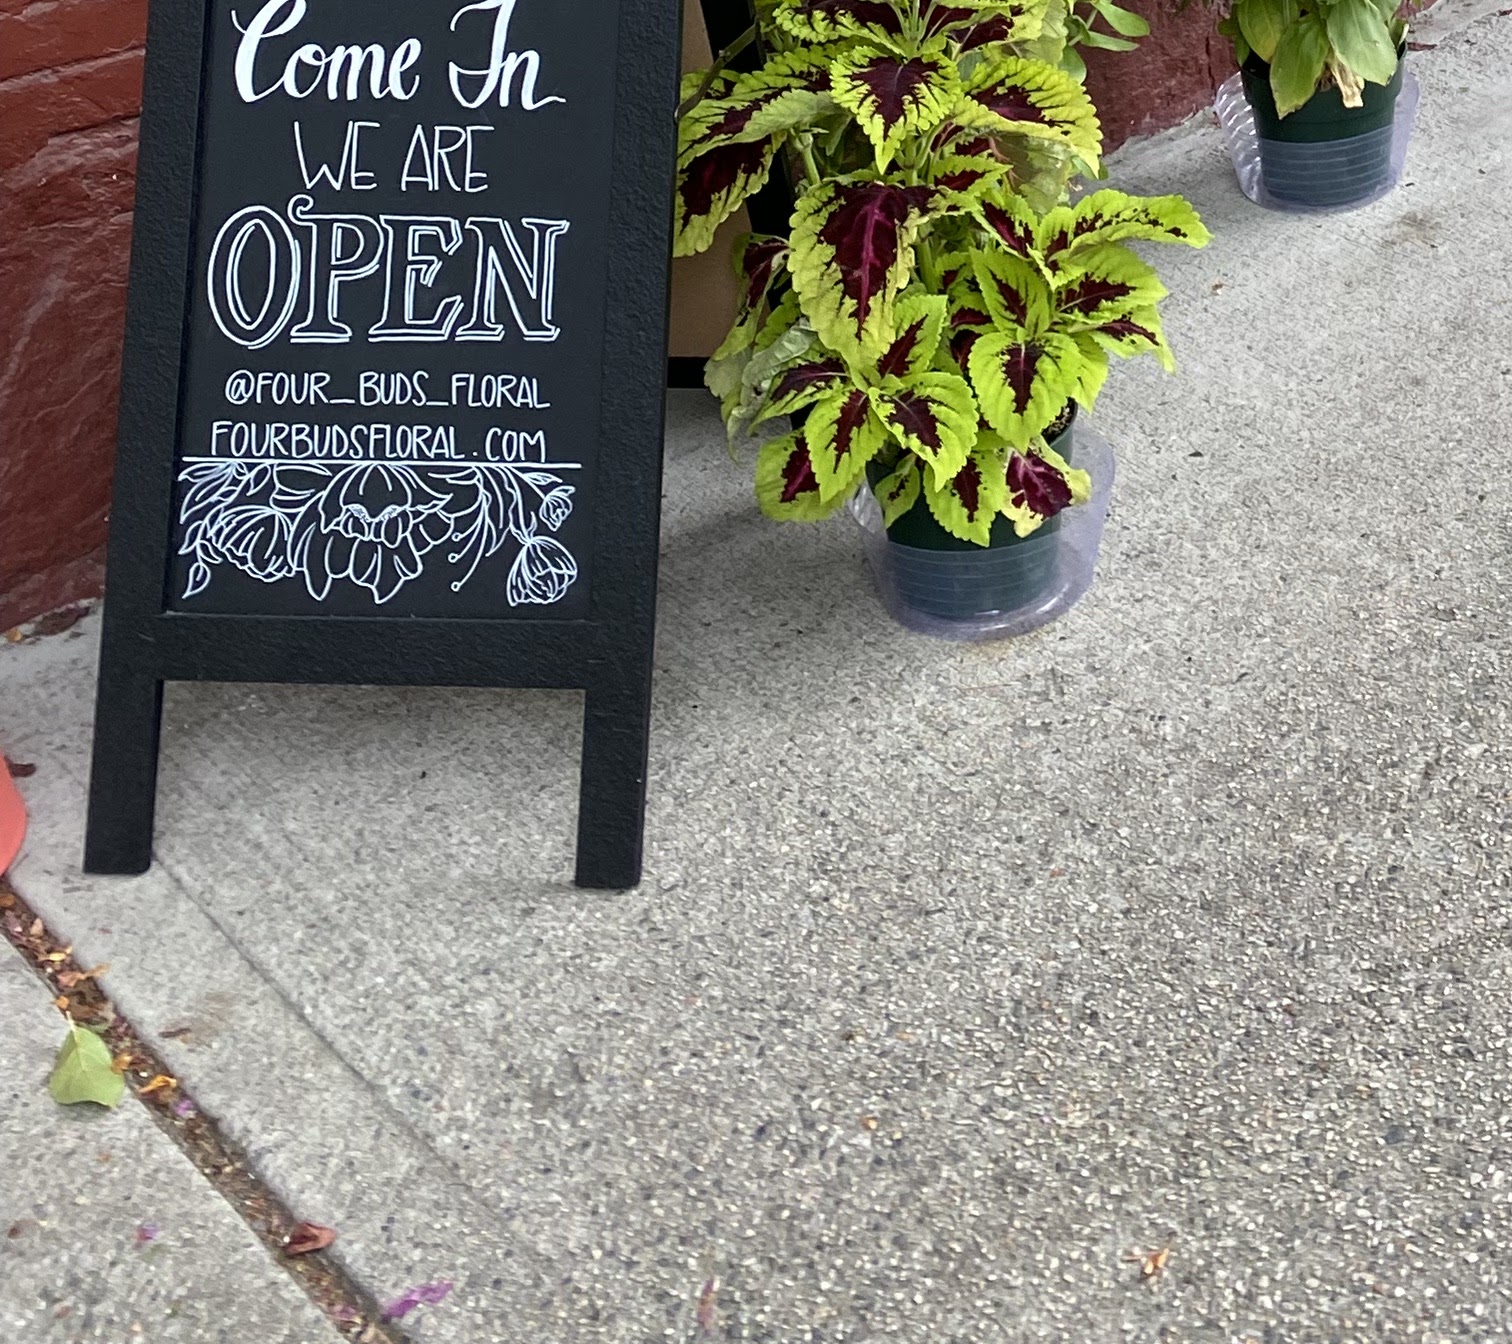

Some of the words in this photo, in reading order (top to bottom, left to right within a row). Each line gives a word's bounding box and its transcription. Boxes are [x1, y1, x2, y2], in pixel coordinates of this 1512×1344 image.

[294, 120, 381, 191] WE
[401, 123, 495, 193] ARE
[207, 194, 571, 349] OPEN
[224, 369, 551, 408] @FOUR_BUDS_FLORAL
